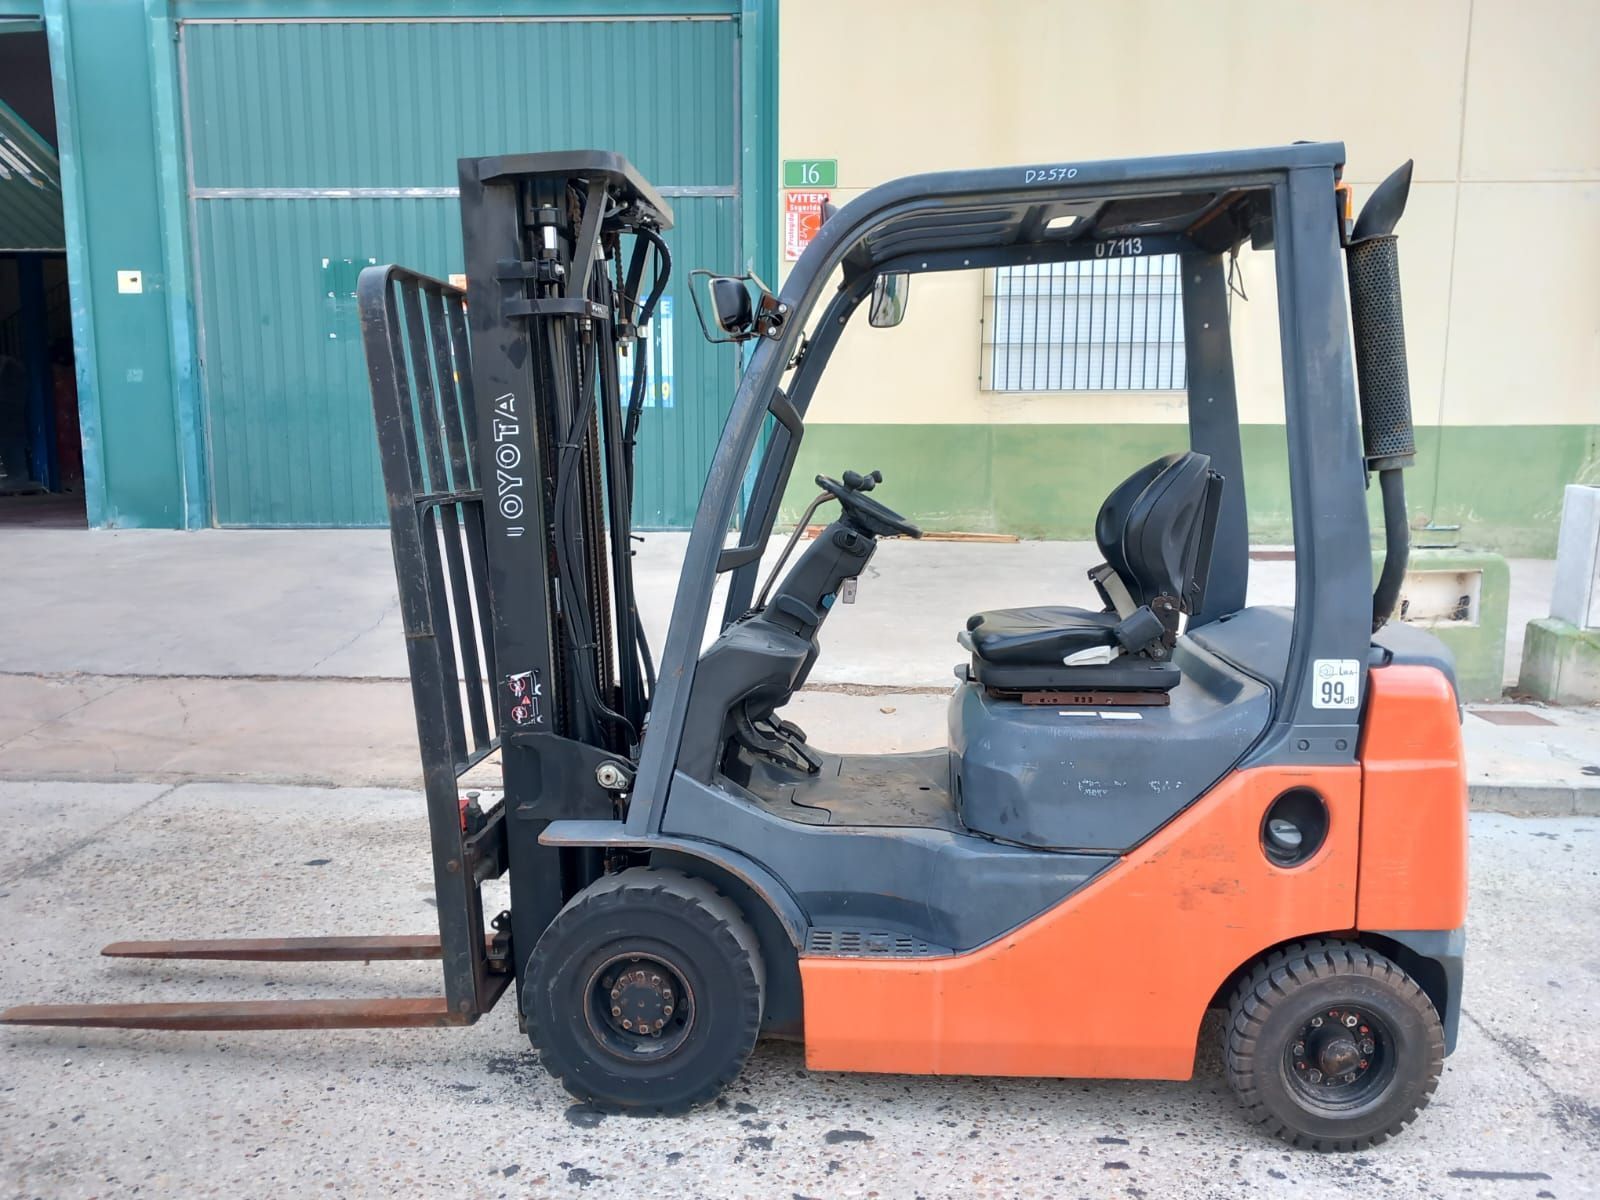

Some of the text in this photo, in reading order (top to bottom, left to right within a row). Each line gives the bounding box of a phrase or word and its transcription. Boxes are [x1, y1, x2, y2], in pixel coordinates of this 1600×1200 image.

[801, 163, 820, 184] 16
[1025, 168, 1078, 184] D2570
[1095, 238, 1143, 257] 07113
[1321, 681, 1355, 705] 99 dB
